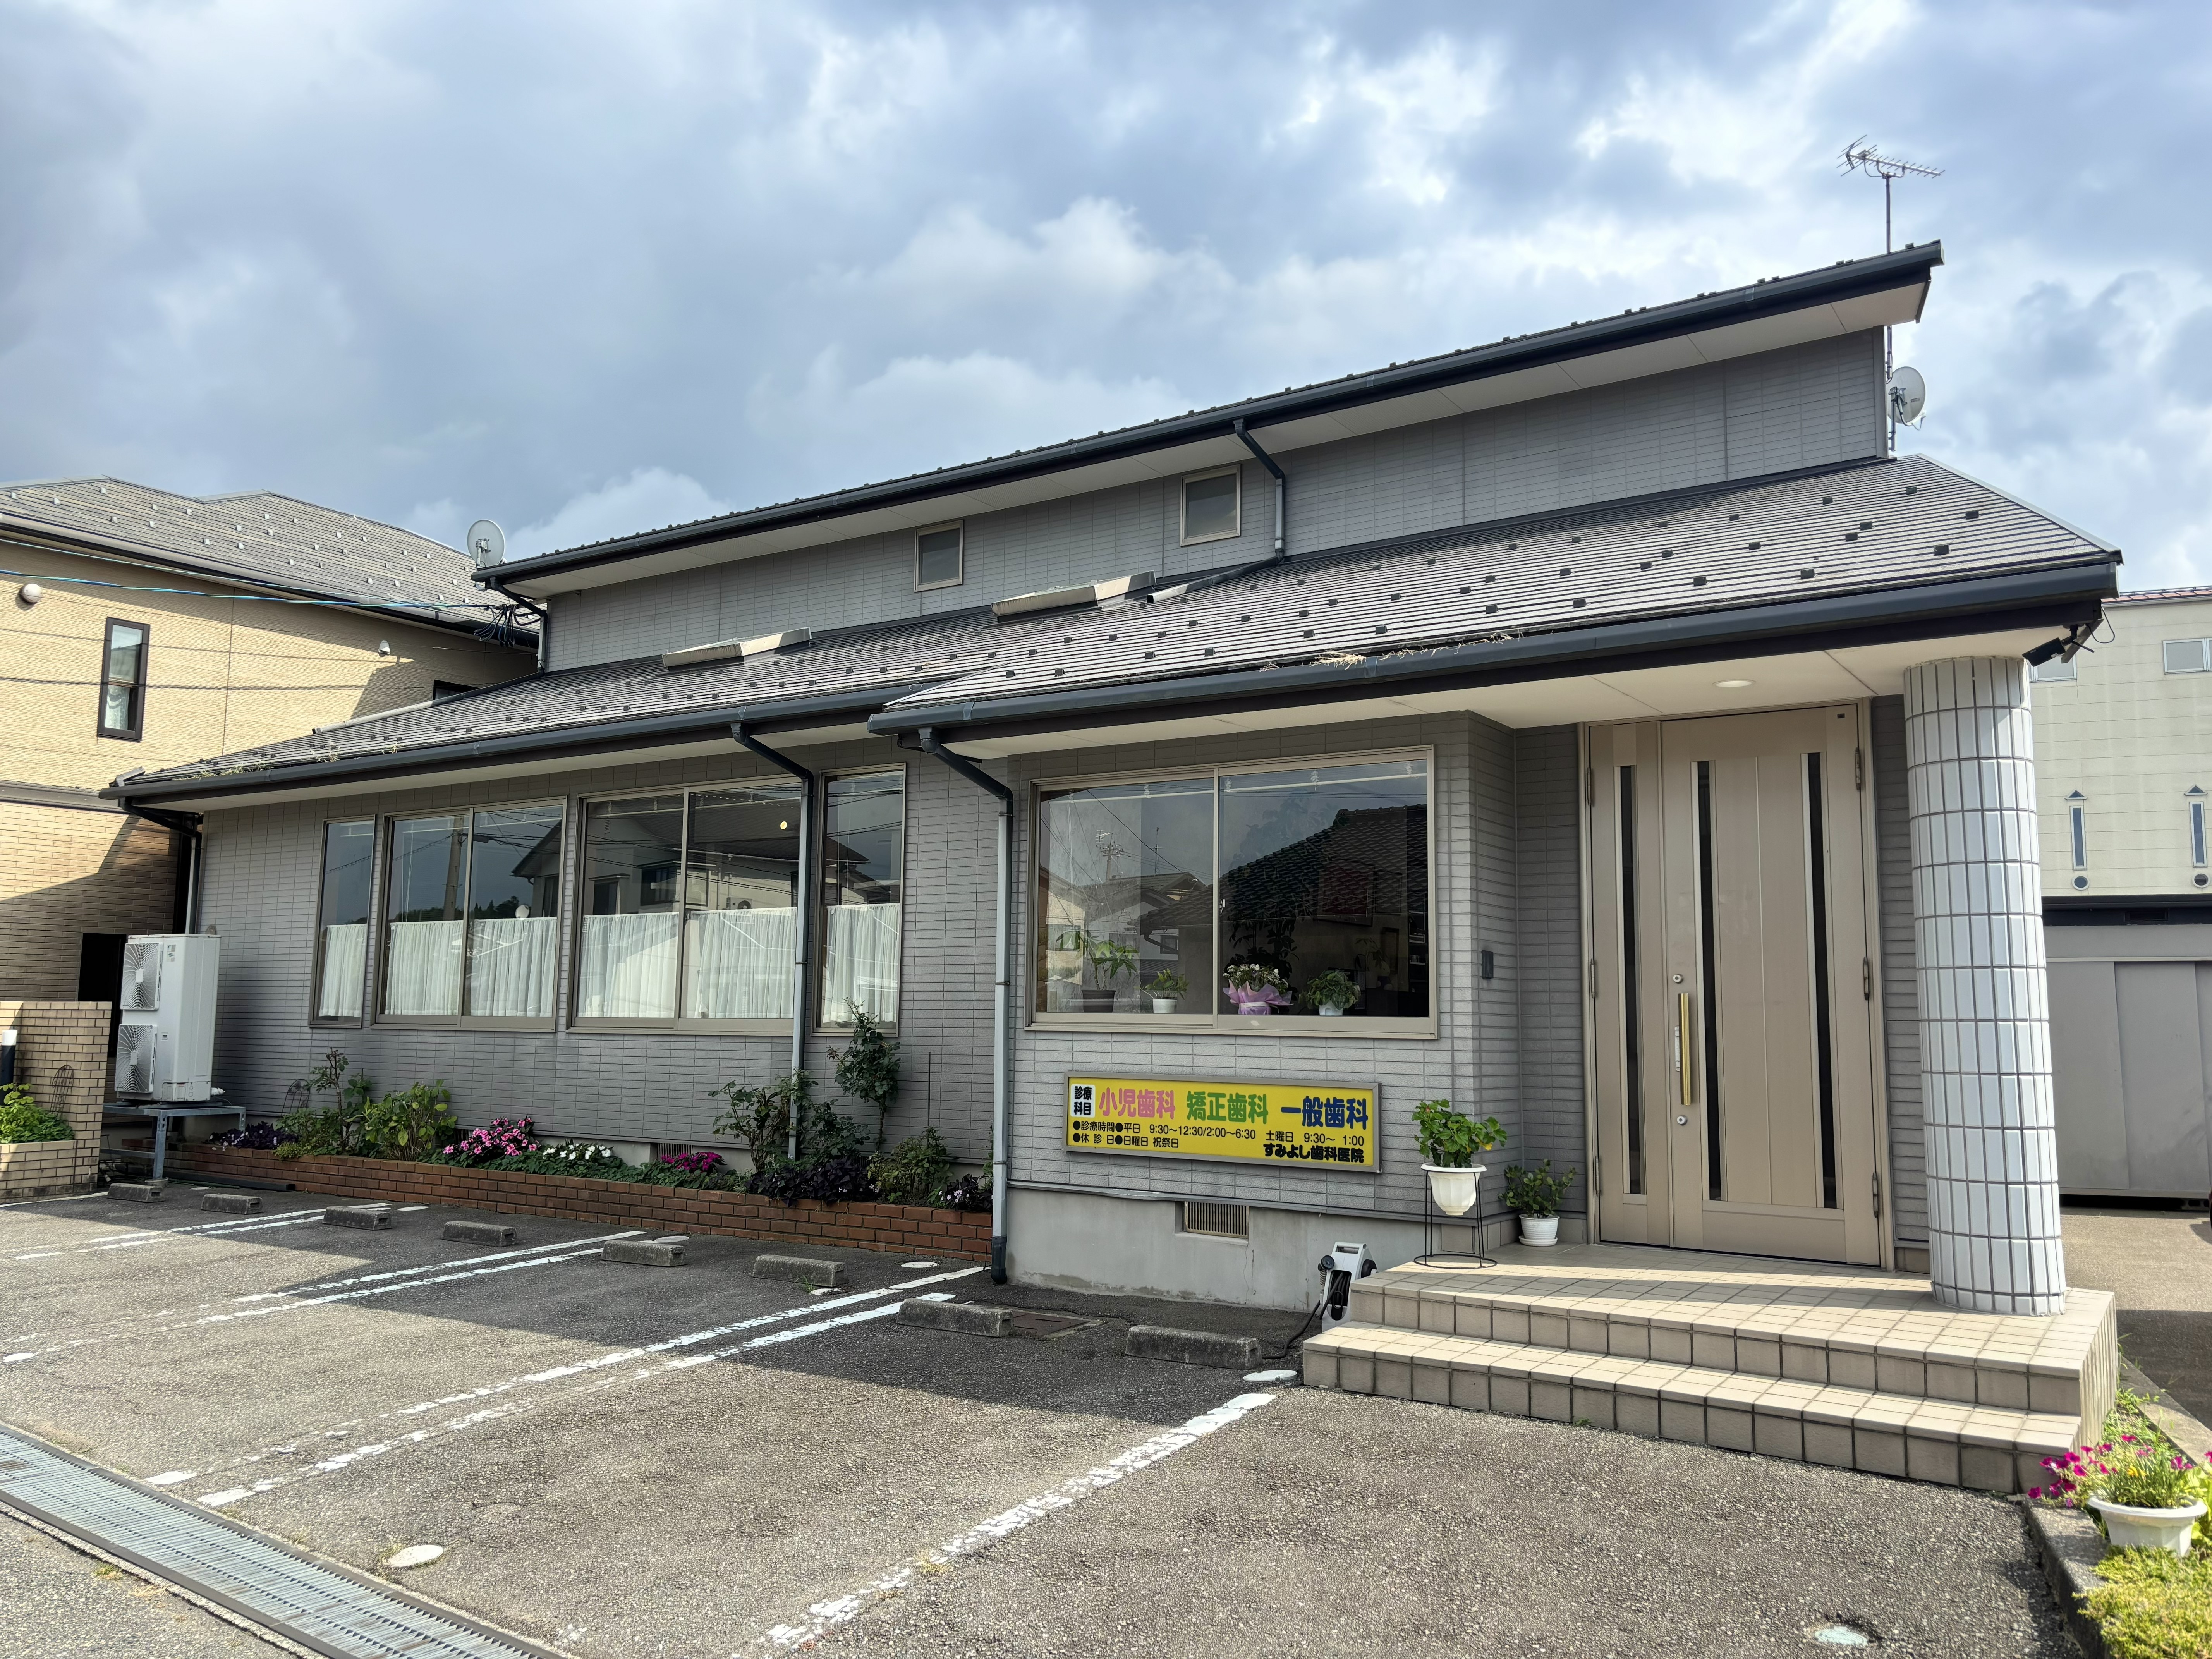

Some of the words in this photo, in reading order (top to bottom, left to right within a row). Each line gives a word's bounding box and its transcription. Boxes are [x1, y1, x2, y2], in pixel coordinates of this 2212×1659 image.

[1074, 1086, 1092, 1100] 診療
[1074, 1101, 1091, 1116] 科目
[1099, 1087, 1176, 1119] 小児歯科
[1187, 1091, 1269, 1125] 矯正歯科
[1281, 1096, 1369, 1130] 一般歯科
[1153, 1137, 1179, 1148] 祝祭日
[1266, 1130, 1293, 1142] 土曜日
[1263, 1143, 1364, 1163] すみよし歯科医院
